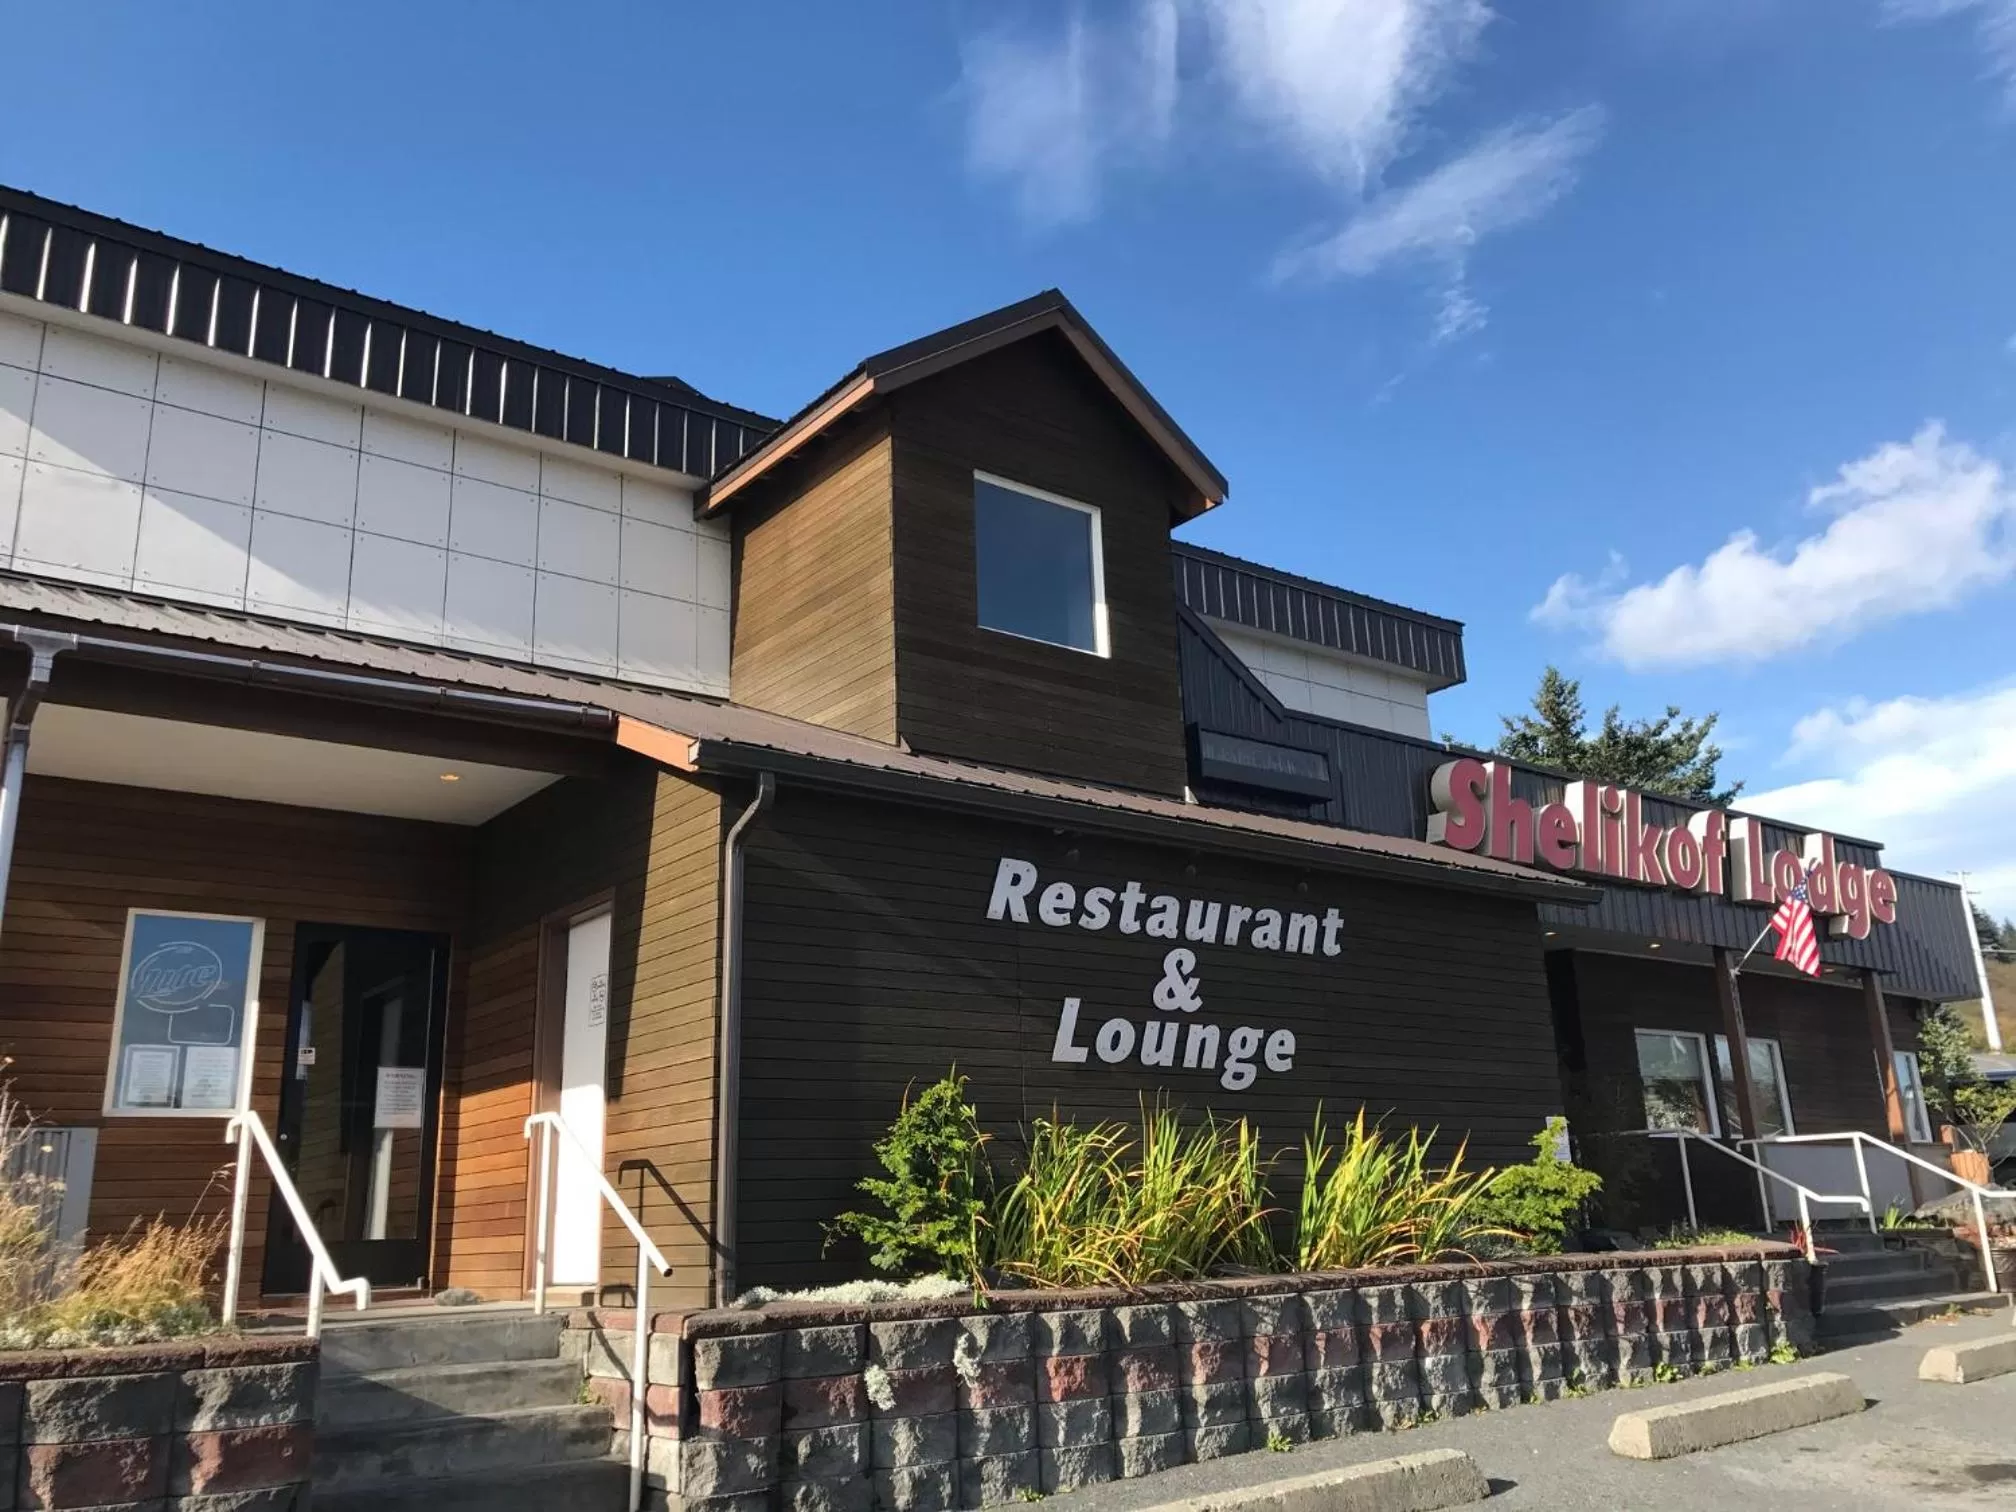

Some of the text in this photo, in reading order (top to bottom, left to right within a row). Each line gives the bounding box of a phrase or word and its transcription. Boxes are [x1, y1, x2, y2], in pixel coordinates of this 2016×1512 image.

[1427, 757, 1897, 940] Shelikof Lodge
[986, 857, 1345, 957] Restaurant
[1153, 948, 1204, 1013] &
[1052, 997, 1297, 1091] Lounge
